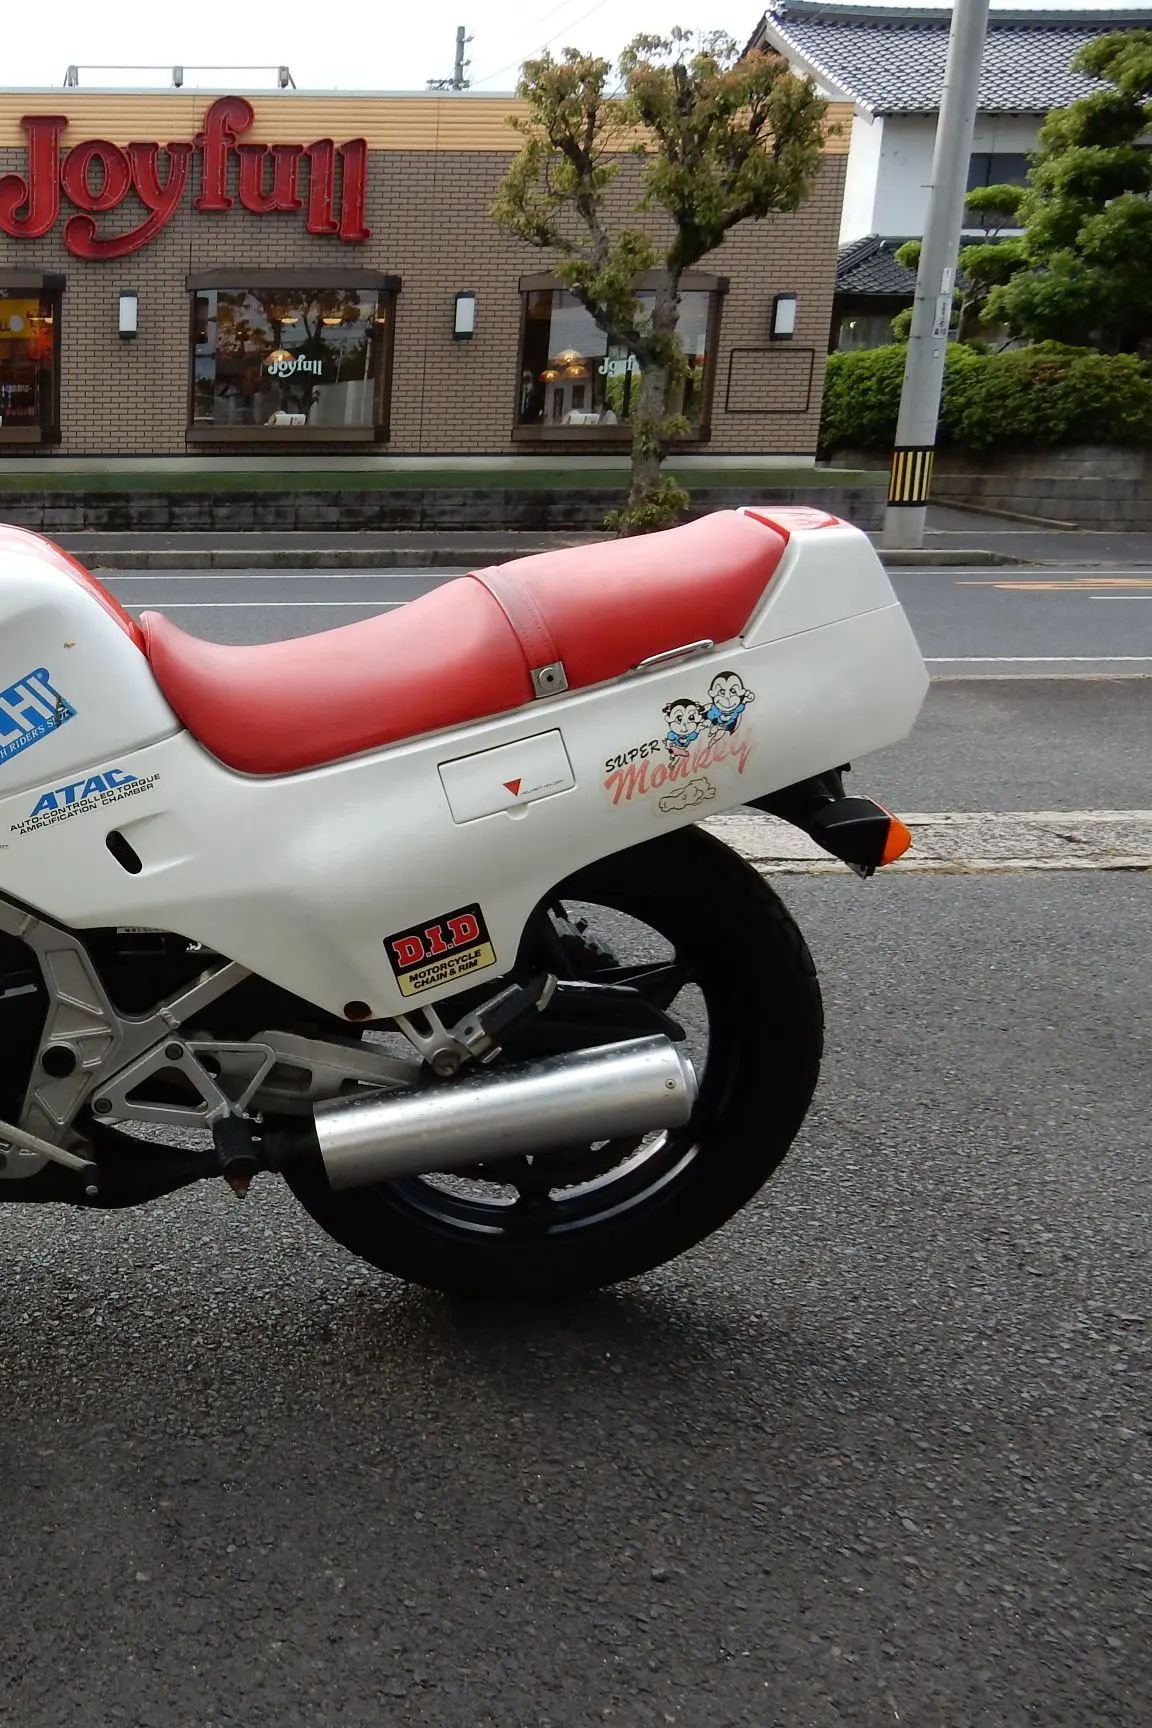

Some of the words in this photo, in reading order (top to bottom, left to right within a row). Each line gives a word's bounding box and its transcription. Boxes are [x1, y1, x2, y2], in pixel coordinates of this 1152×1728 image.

[268, 354, 323, 378] Joyfull
[604, 731, 752, 806] Monkey
[605, 739, 661, 773] SUPER
[10, 790, 114, 831] AUTO-CONTROLLED
[118, 773, 161, 794] TORQUE
[19, 802, 97, 835] AMPLIFICATION
[102, 783, 154, 806] CHAMBER
[30, 768, 138, 817] ATAC
[391, 913, 480, 968] D.I.D
[409, 949, 481, 983] MOTORCYCLE
[414, 969, 447, 989] CHAIN
[448, 967, 457, 976] &
[458, 959, 478, 973] RIM
